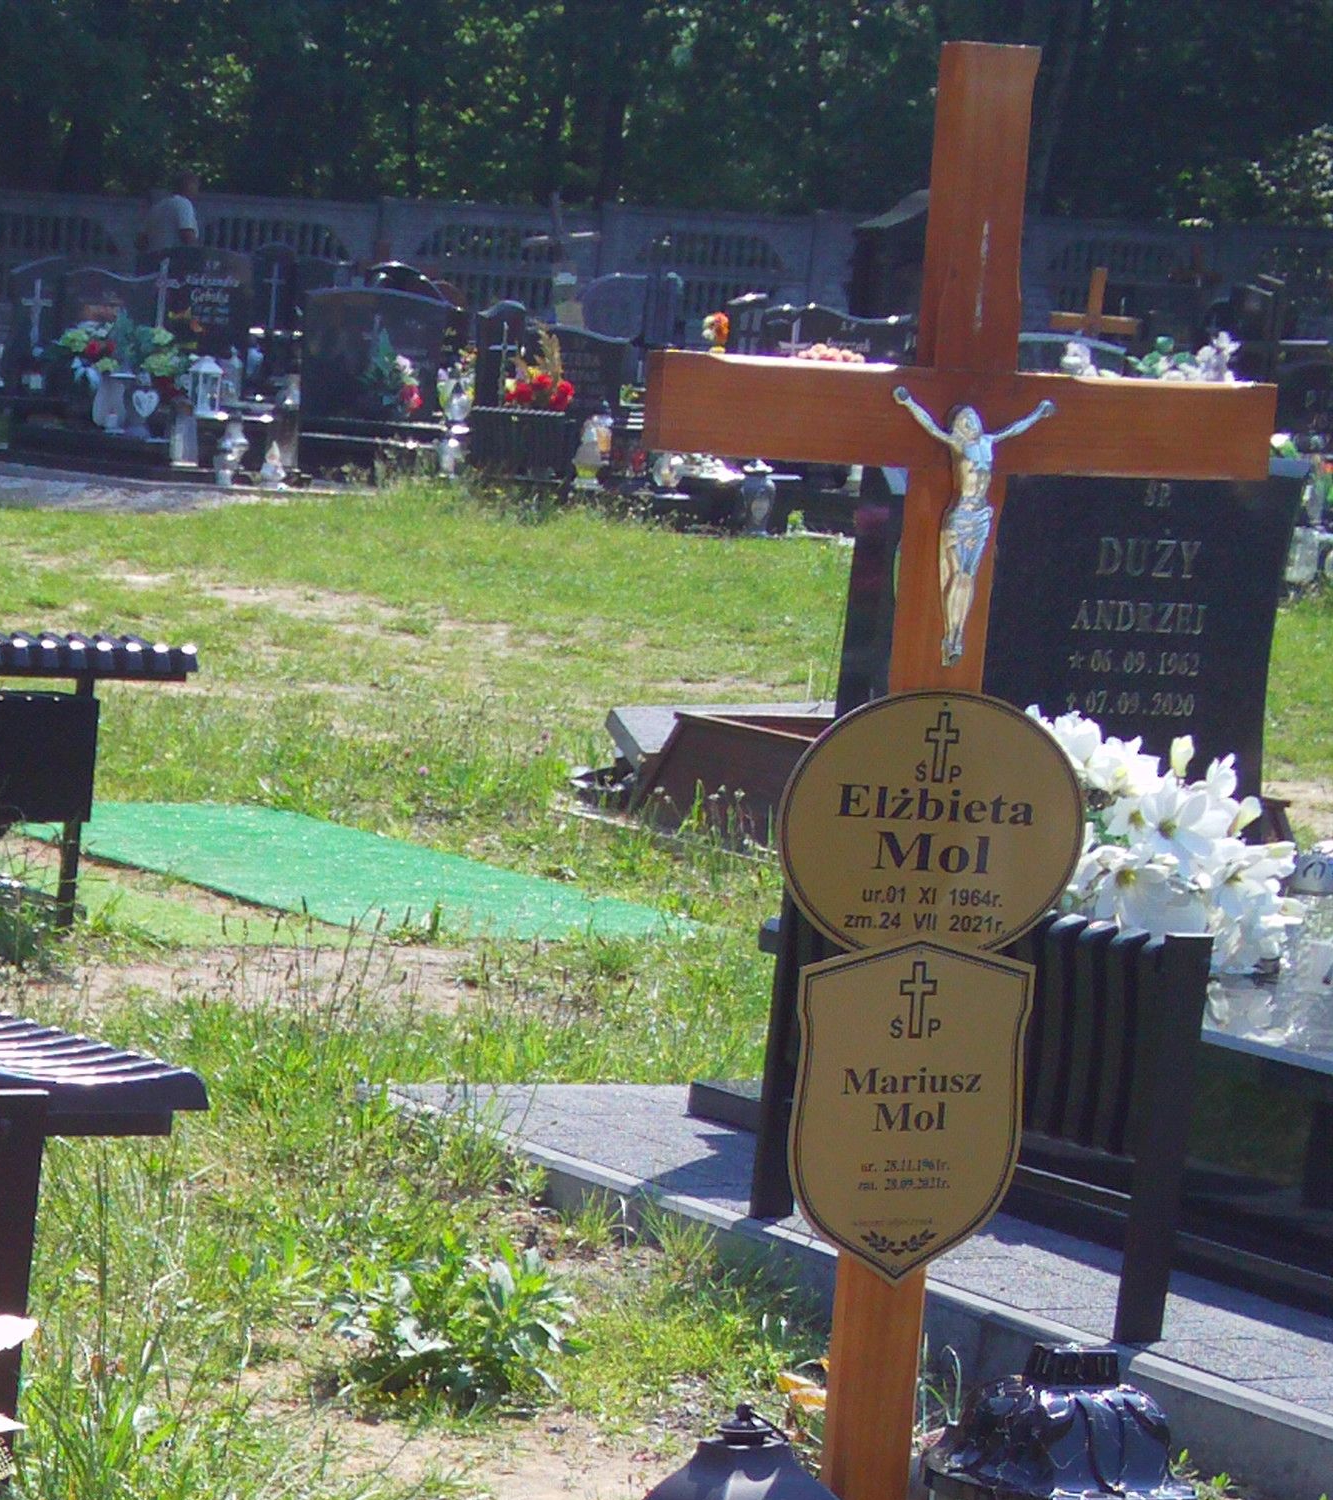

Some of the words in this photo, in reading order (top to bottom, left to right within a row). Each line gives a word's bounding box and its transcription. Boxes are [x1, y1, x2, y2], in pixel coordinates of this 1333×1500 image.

[1095, 528, 1202, 579] DUŻY
[1071, 600, 1207, 635] ANDRZEJ
[834, 783, 1034, 826] Elżbieta
[871, 831, 990, 874] Mol
[918, 886, 937, 906] XI
[913, 913, 937, 931] VII
[840, 1066, 982, 1096] Mariusz
[871, 1102, 946, 1132] Mol
